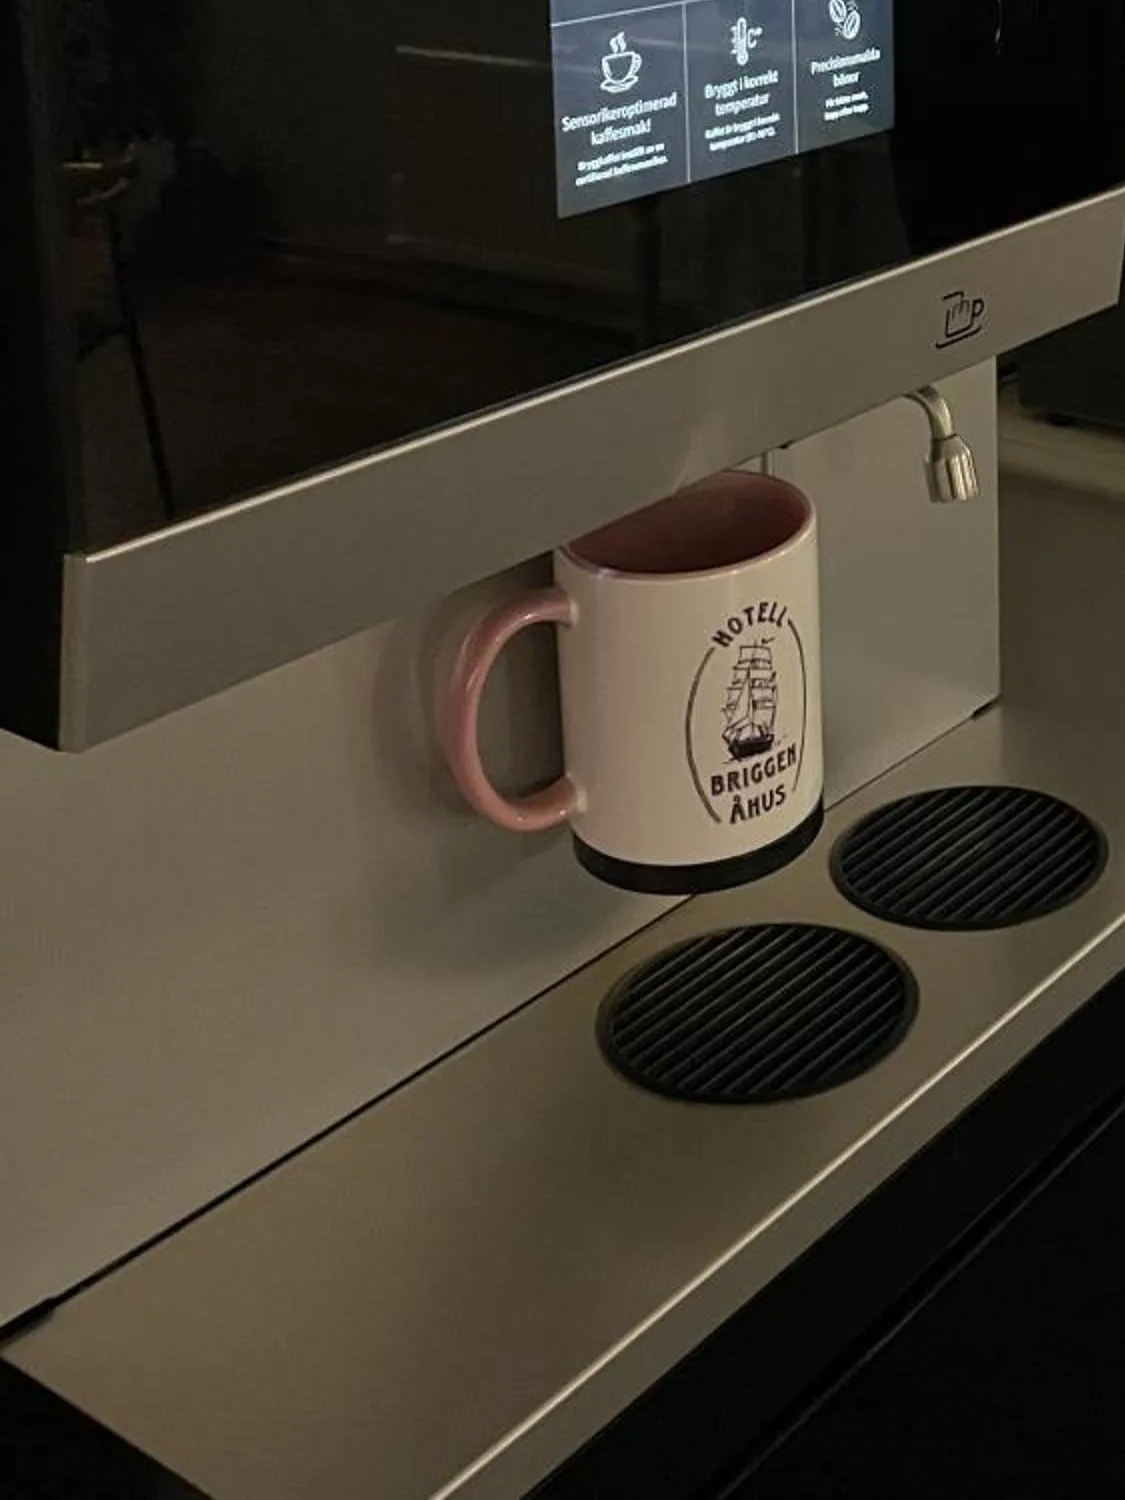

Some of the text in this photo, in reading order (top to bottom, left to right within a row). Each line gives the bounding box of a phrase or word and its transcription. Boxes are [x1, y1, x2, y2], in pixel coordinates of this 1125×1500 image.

[711, 601, 788, 648] HOTELL
[711, 743, 797, 797] BRIGGEN
[729, 784, 787, 825] ÅHUS
